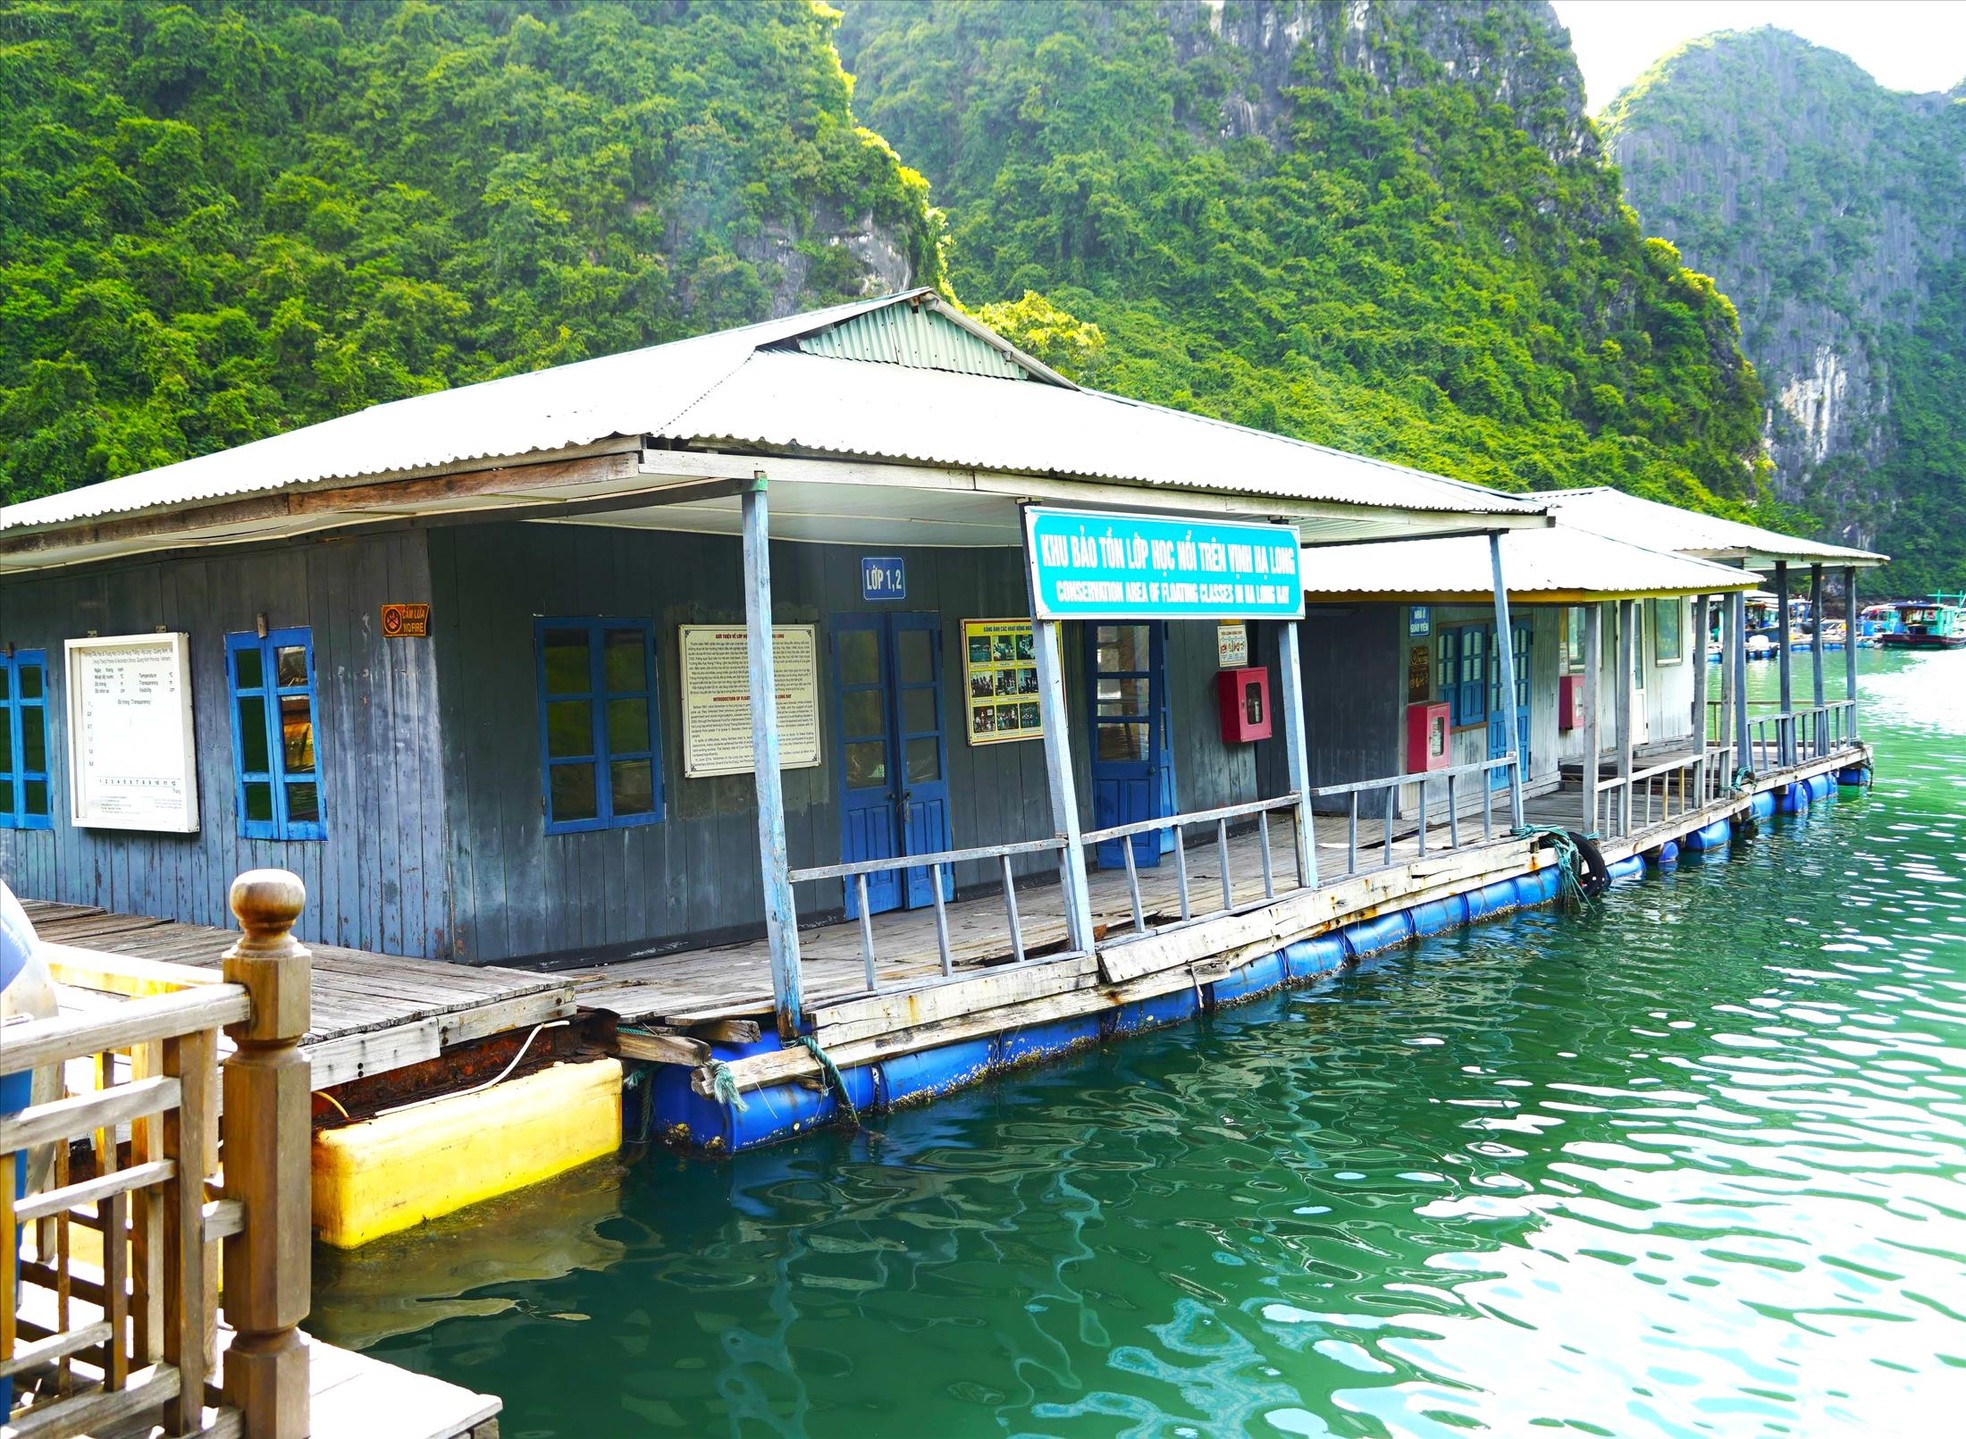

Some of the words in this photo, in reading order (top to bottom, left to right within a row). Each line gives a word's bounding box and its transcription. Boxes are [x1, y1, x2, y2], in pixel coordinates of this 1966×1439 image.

[1040, 534, 1069, 568] KHU
[1070, 525, 1098, 569] BẢO
[1125, 531, 1149, 570] LỚP
[1150, 539, 1175, 577] HỌC
[1177, 529, 1197, 571] NỔI
[1198, 536, 1227, 572] TRÊN
[1227, 543, 1253, 579] VỊNH
[1254, 545, 1269, 580] HẠ
[1269, 546, 1296, 575] LONG
[866, 564, 884, 590] LỚP
[886, 569, 902, 592] 1,2
[1056, 580, 1124, 603] CONSERVATION
[1125, 581, 1148, 603] AREA
[1149, 581, 1160, 603] OF
[1161, 582, 1199, 603] FLOATING
[1199, 583, 1234, 603] CLASSES
[1235, 584, 1244, 604] IN
[1256, 585, 1275, 604] LONG
[1276, 585, 1290, 604] BAY
[403, 622, 411, 633] NO
